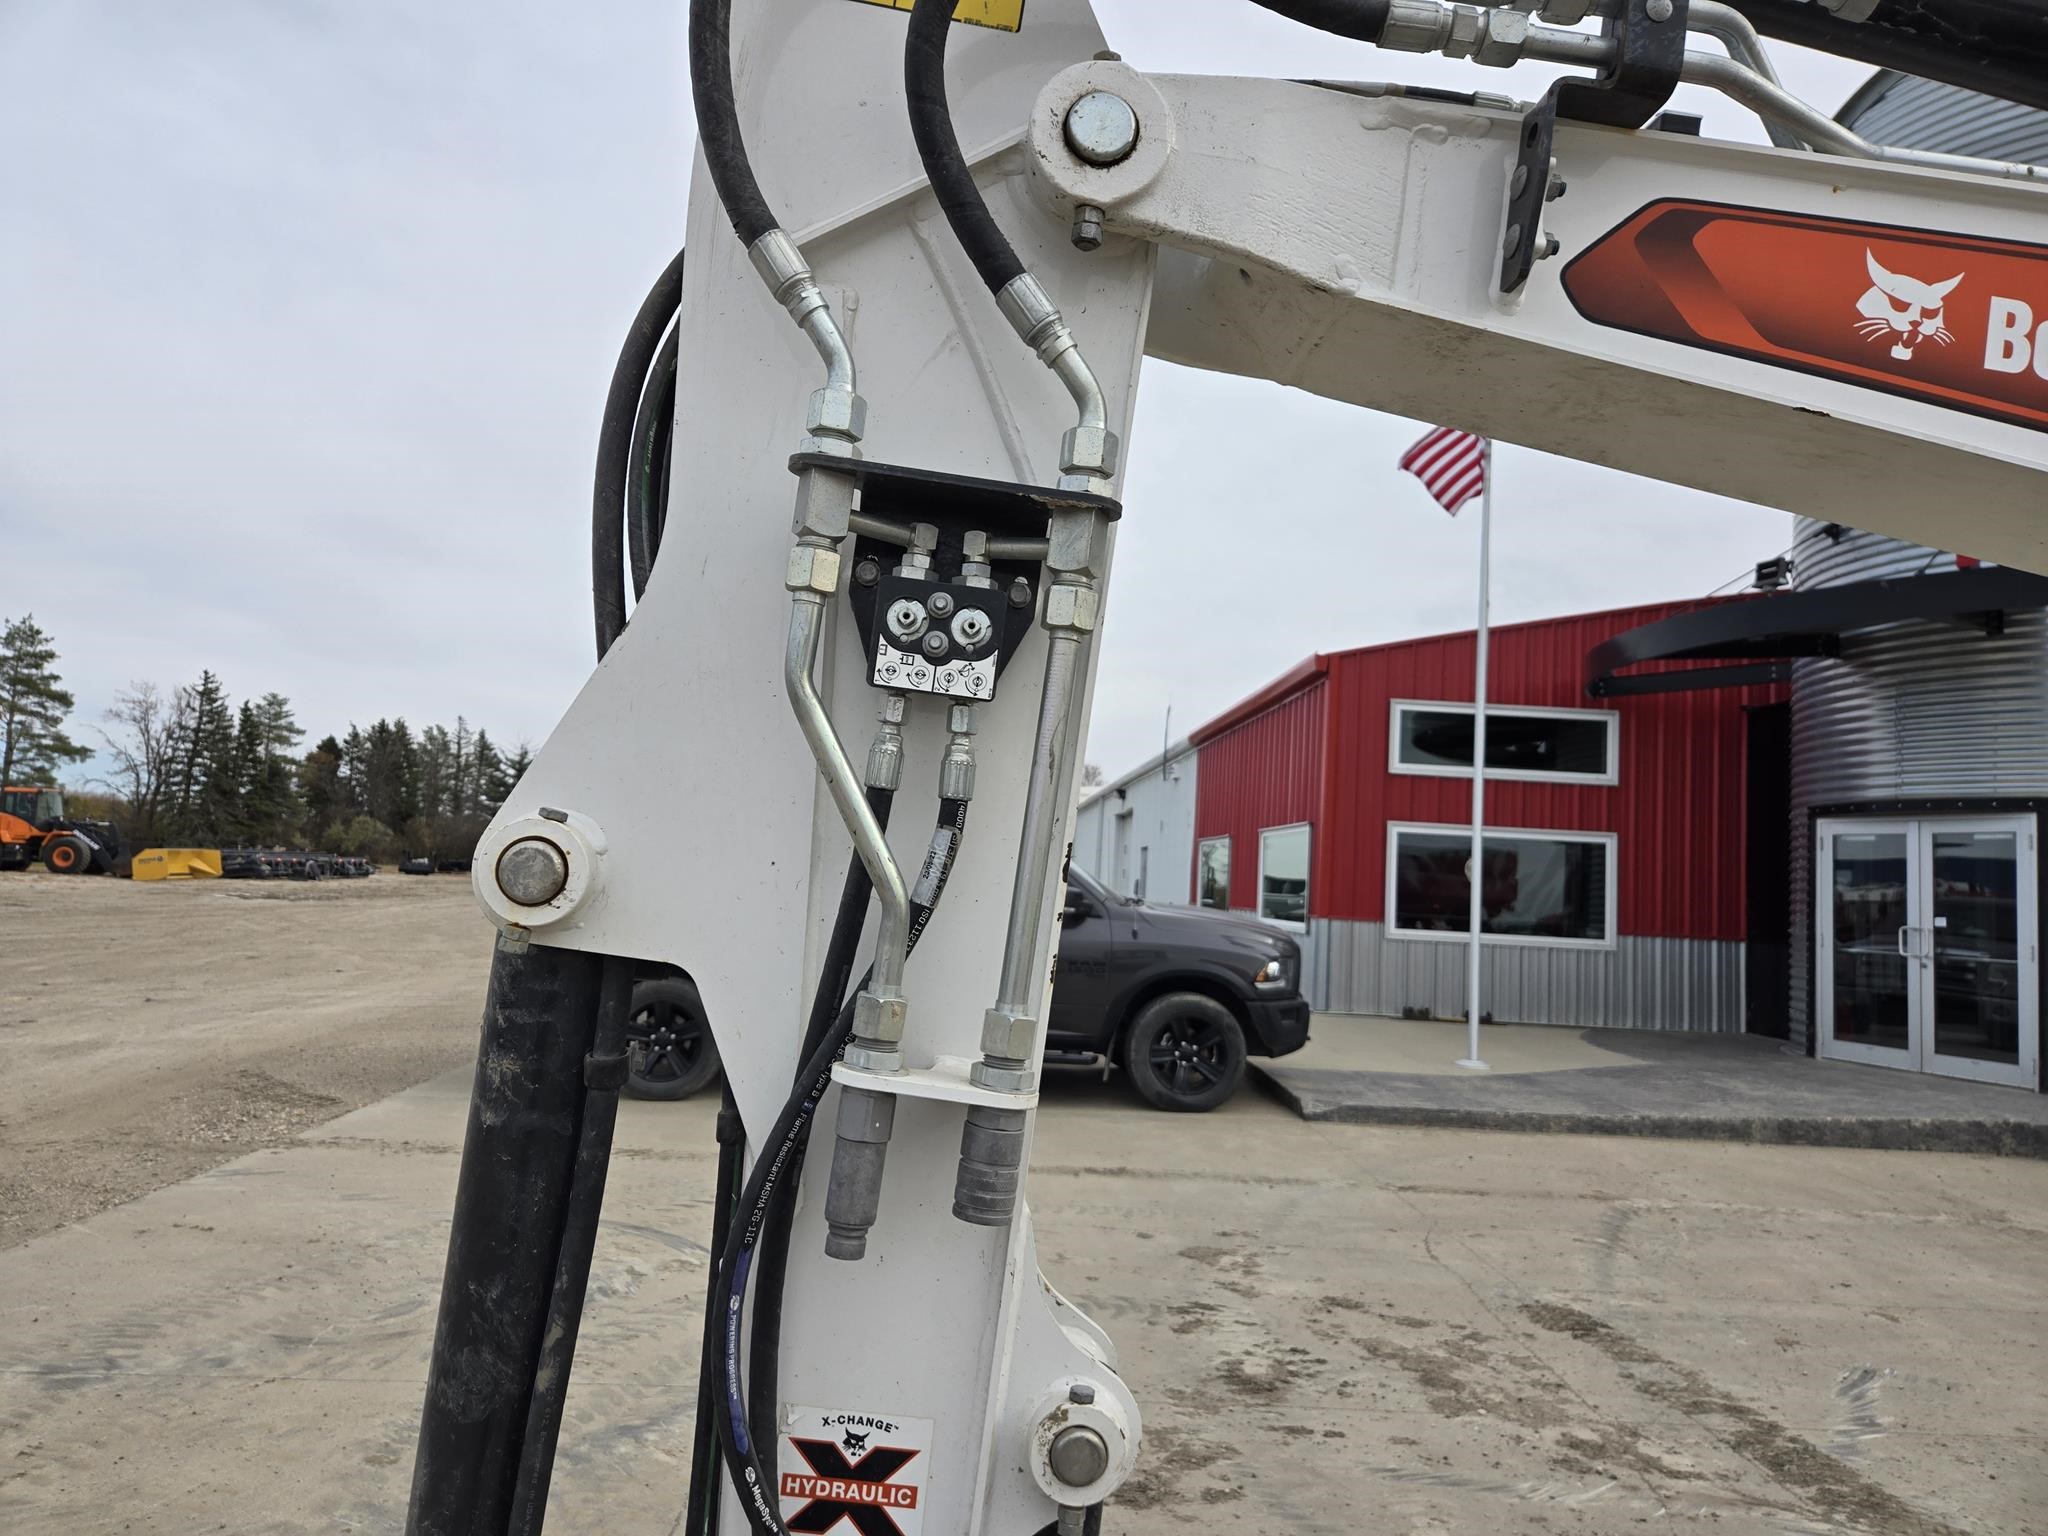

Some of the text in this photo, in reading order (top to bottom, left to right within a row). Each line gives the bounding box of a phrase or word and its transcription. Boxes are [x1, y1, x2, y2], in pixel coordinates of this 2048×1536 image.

[918, 908, 931, 924] ISO
[744, 1112, 807, 1244] Flame Resistant MSHA 2G-11C
[728, 1314, 737, 1354] POWERING
[786, 1476, 912, 1505] HYDRAULIC
